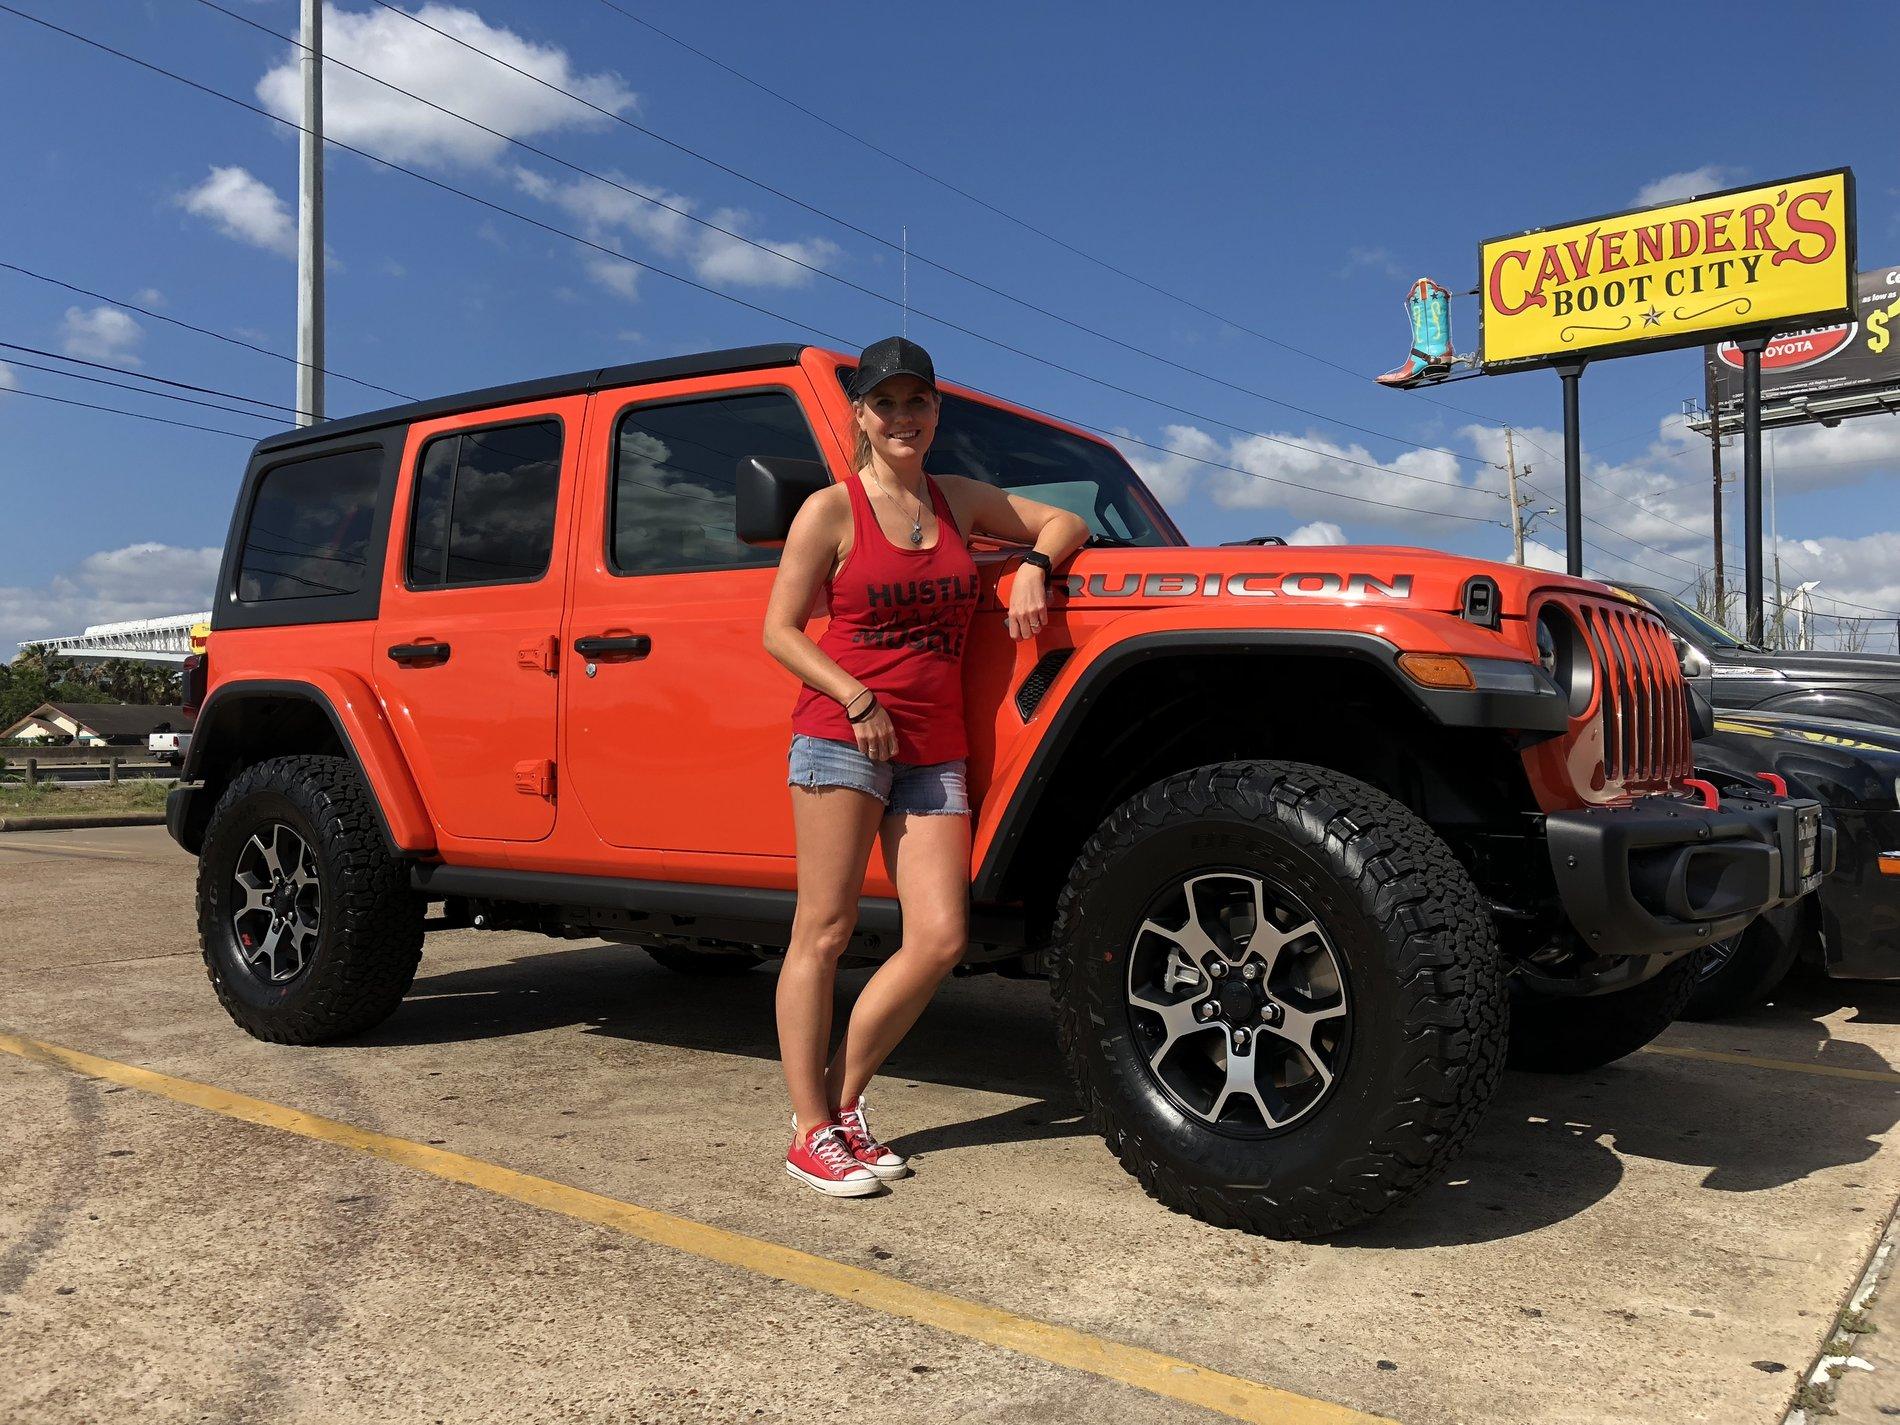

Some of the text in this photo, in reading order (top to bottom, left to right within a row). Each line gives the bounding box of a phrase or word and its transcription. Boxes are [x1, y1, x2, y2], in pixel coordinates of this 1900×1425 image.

[1489, 190, 1837, 316] CAVENDER'S
[1552, 254, 1764, 317] BOOT CITY
[1760, 340, 1813, 359] OYOTA
[1056, 573, 1415, 599] RUBICON
